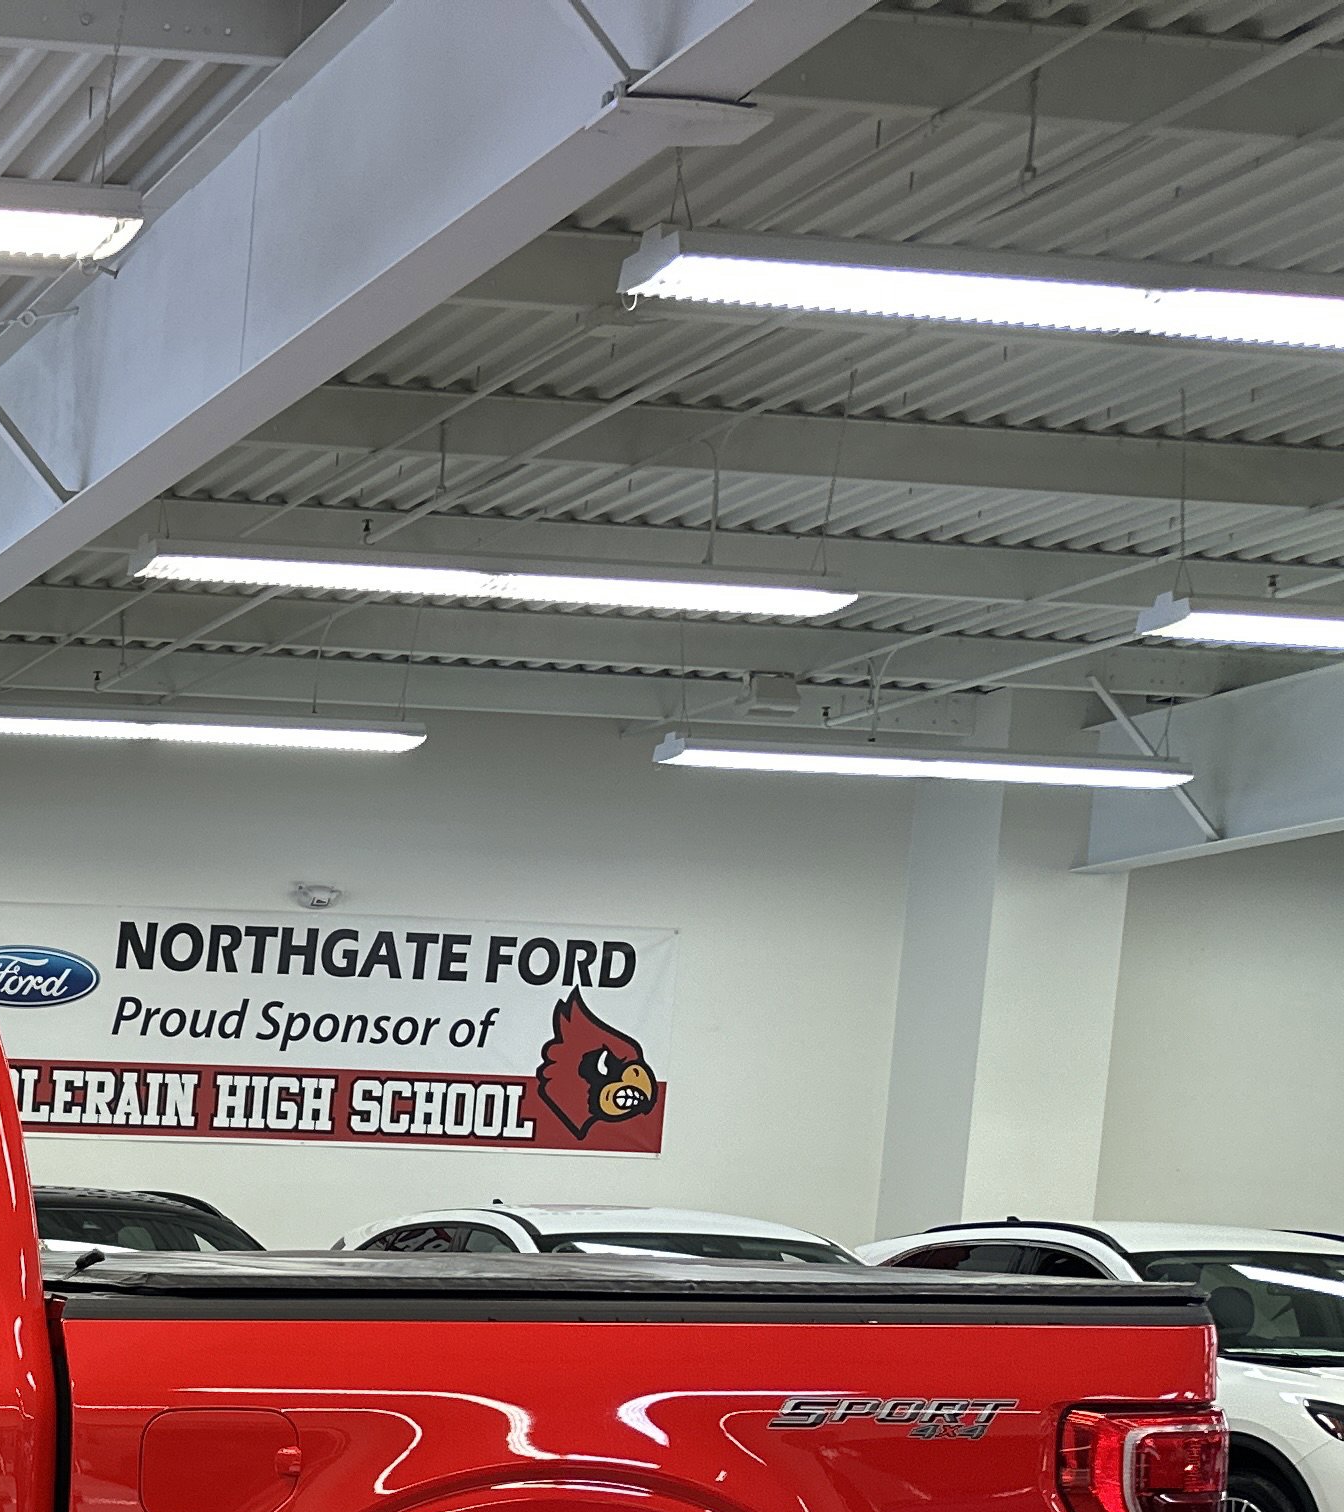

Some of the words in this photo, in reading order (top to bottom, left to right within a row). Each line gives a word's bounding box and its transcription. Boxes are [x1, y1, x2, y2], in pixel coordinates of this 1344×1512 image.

[115, 921, 472, 982] NORTHGATE
[484, 935, 637, 989] FORD
[111, 996, 250, 1039] Proud
[255, 1000, 440, 1052] Sponsor
[448, 1008, 500, 1048] of
[9, 1067, 200, 1127] LERAIN
[212, 1074, 336, 1132] HIGH
[349, 1079, 535, 1139] SCHOOL
[767, 1396, 1019, 1430] SPORT
[908, 1424, 992, 1441] 4x4
